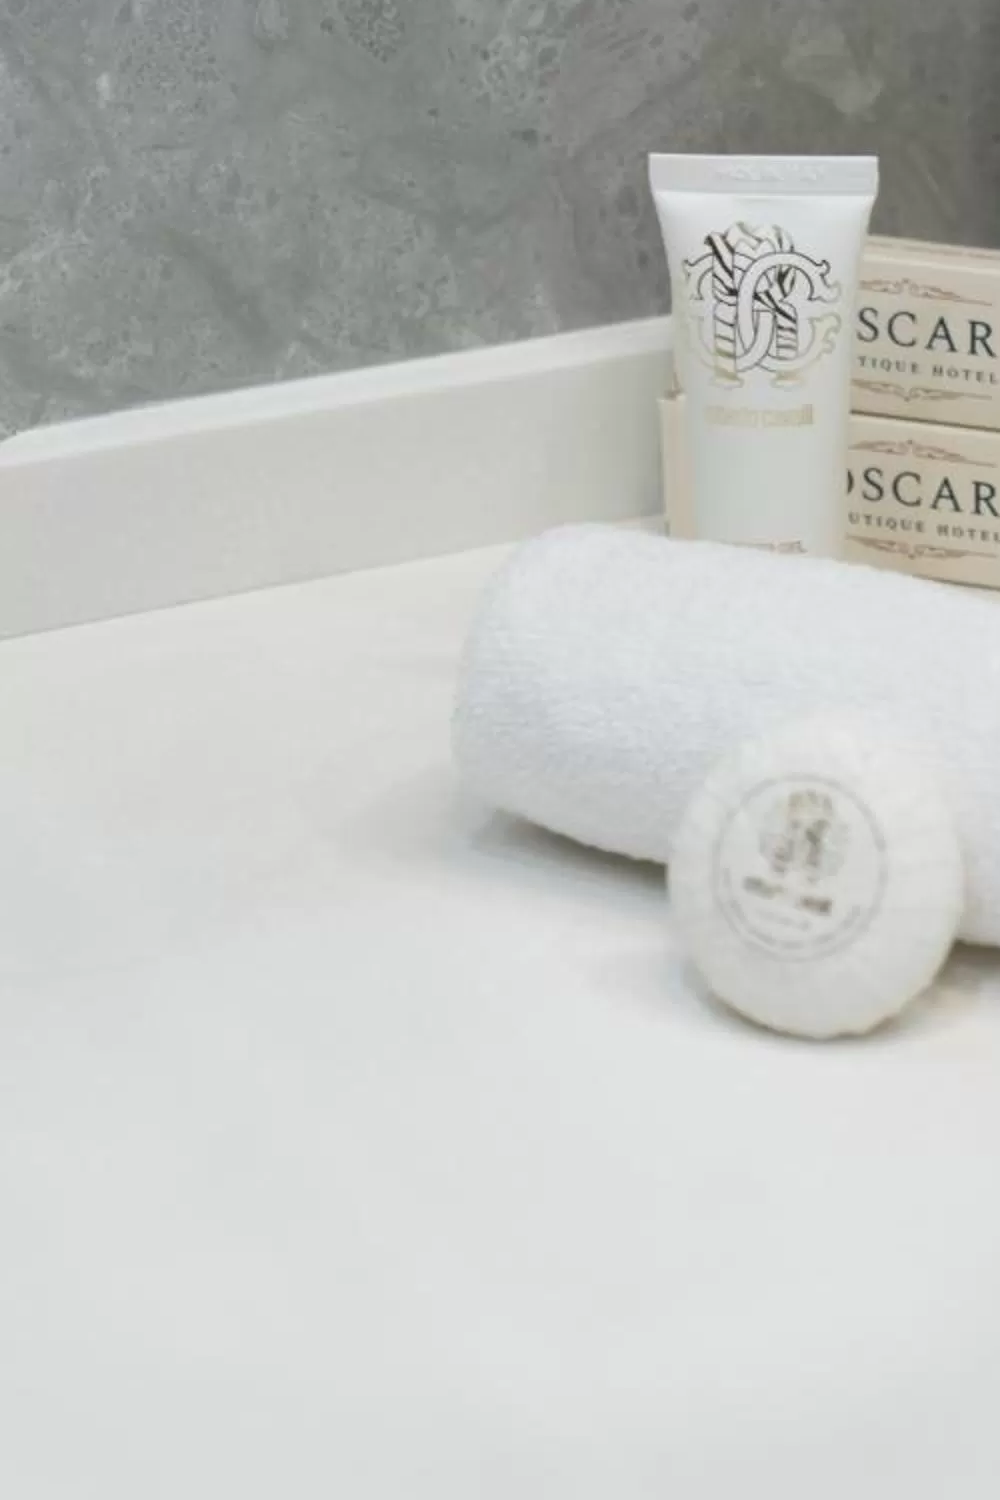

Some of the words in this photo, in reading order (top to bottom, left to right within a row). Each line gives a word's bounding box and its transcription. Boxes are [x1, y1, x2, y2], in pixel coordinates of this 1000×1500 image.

[856, 306, 997, 359] SCAR
[857, 355, 921, 375] TIQUE
[931, 364, 999, 385] HOTEL
[848, 511, 925, 534] UTIQUE
